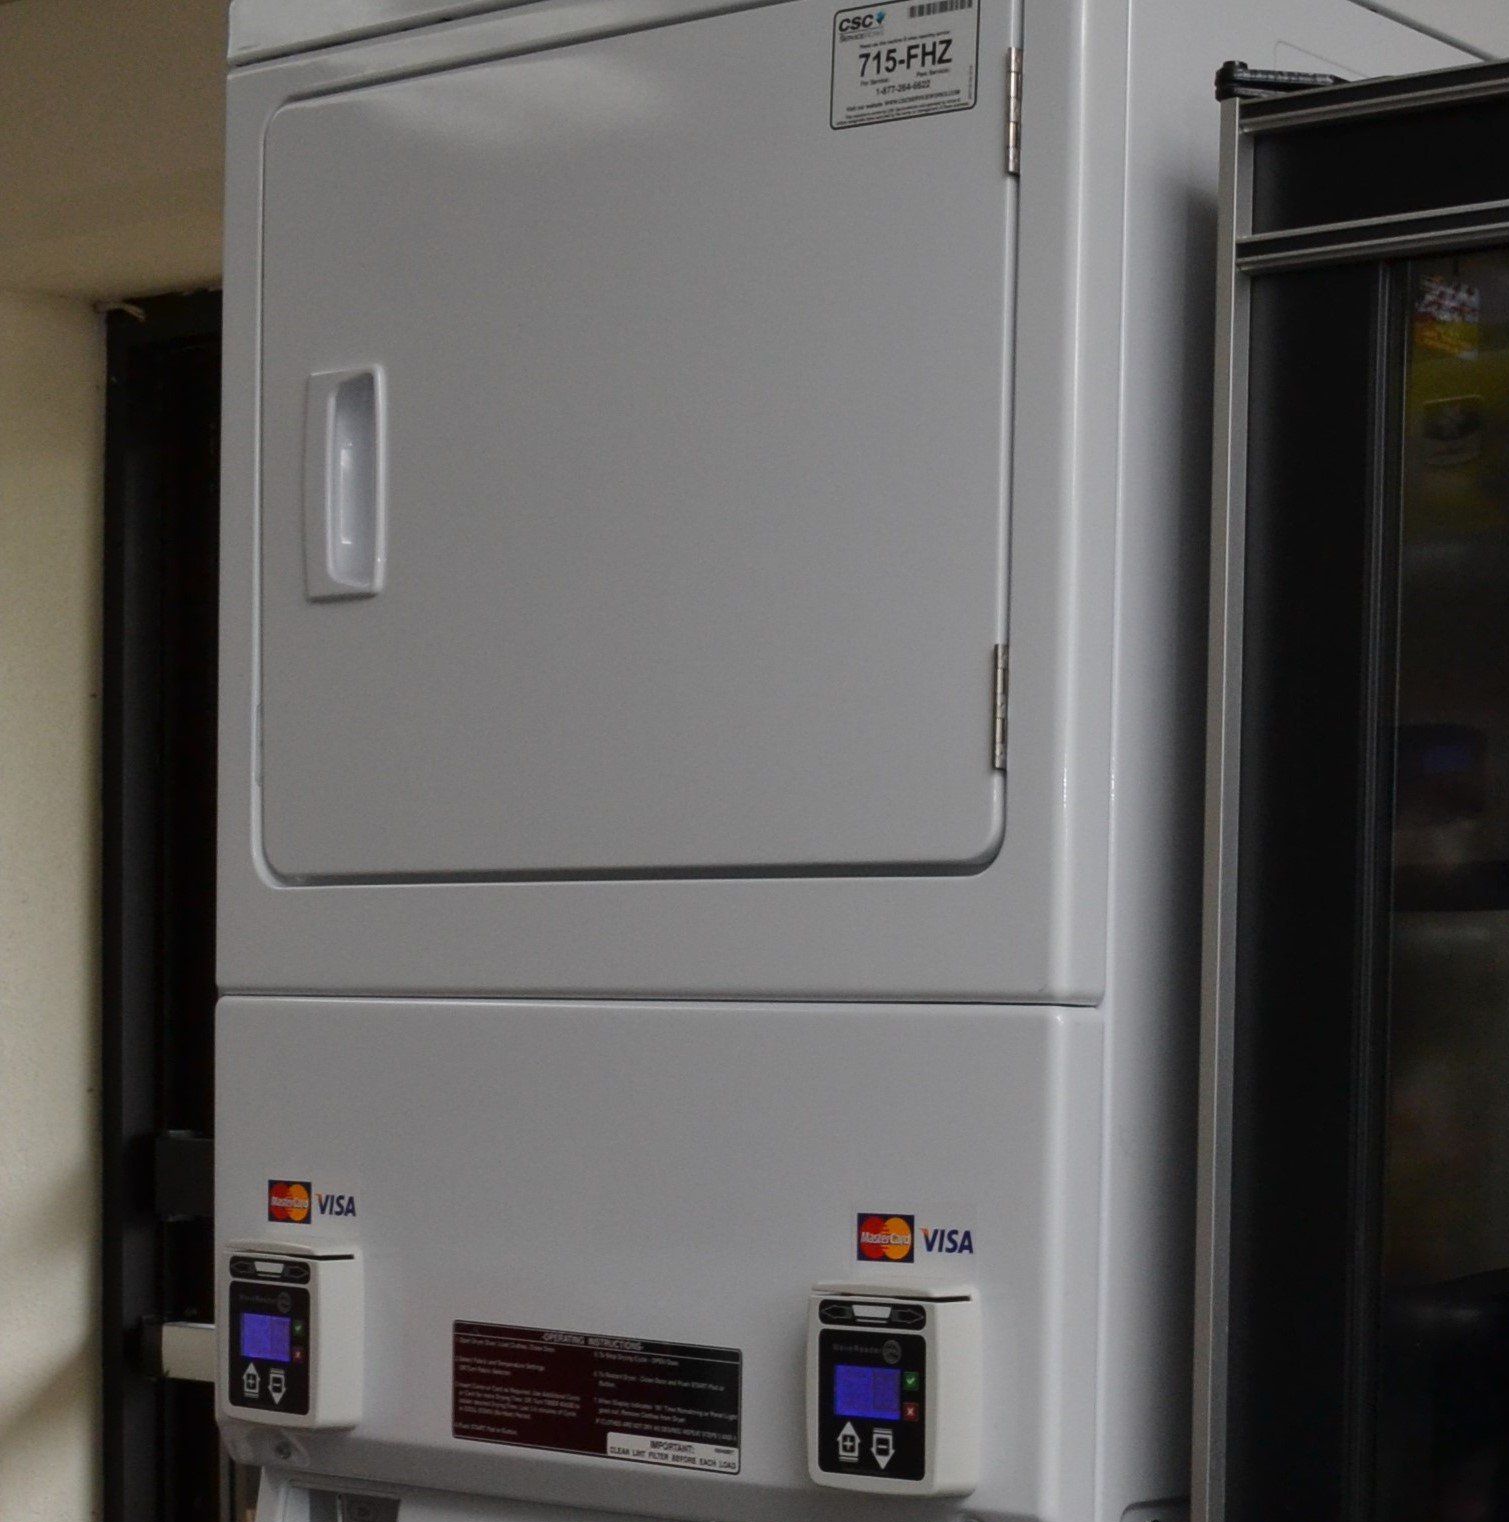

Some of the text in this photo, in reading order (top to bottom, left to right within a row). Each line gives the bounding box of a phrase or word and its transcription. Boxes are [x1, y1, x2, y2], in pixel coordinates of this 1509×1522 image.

[838, 14, 874, 32] CSC
[859, 39, 953, 77] 715-FHZ
[316, 1193, 357, 1217] VISA
[860, 1230, 912, 1246] MasterCard
[920, 1227, 975, 1254] VISA
[648, 1451, 669, 1460] FILTER
